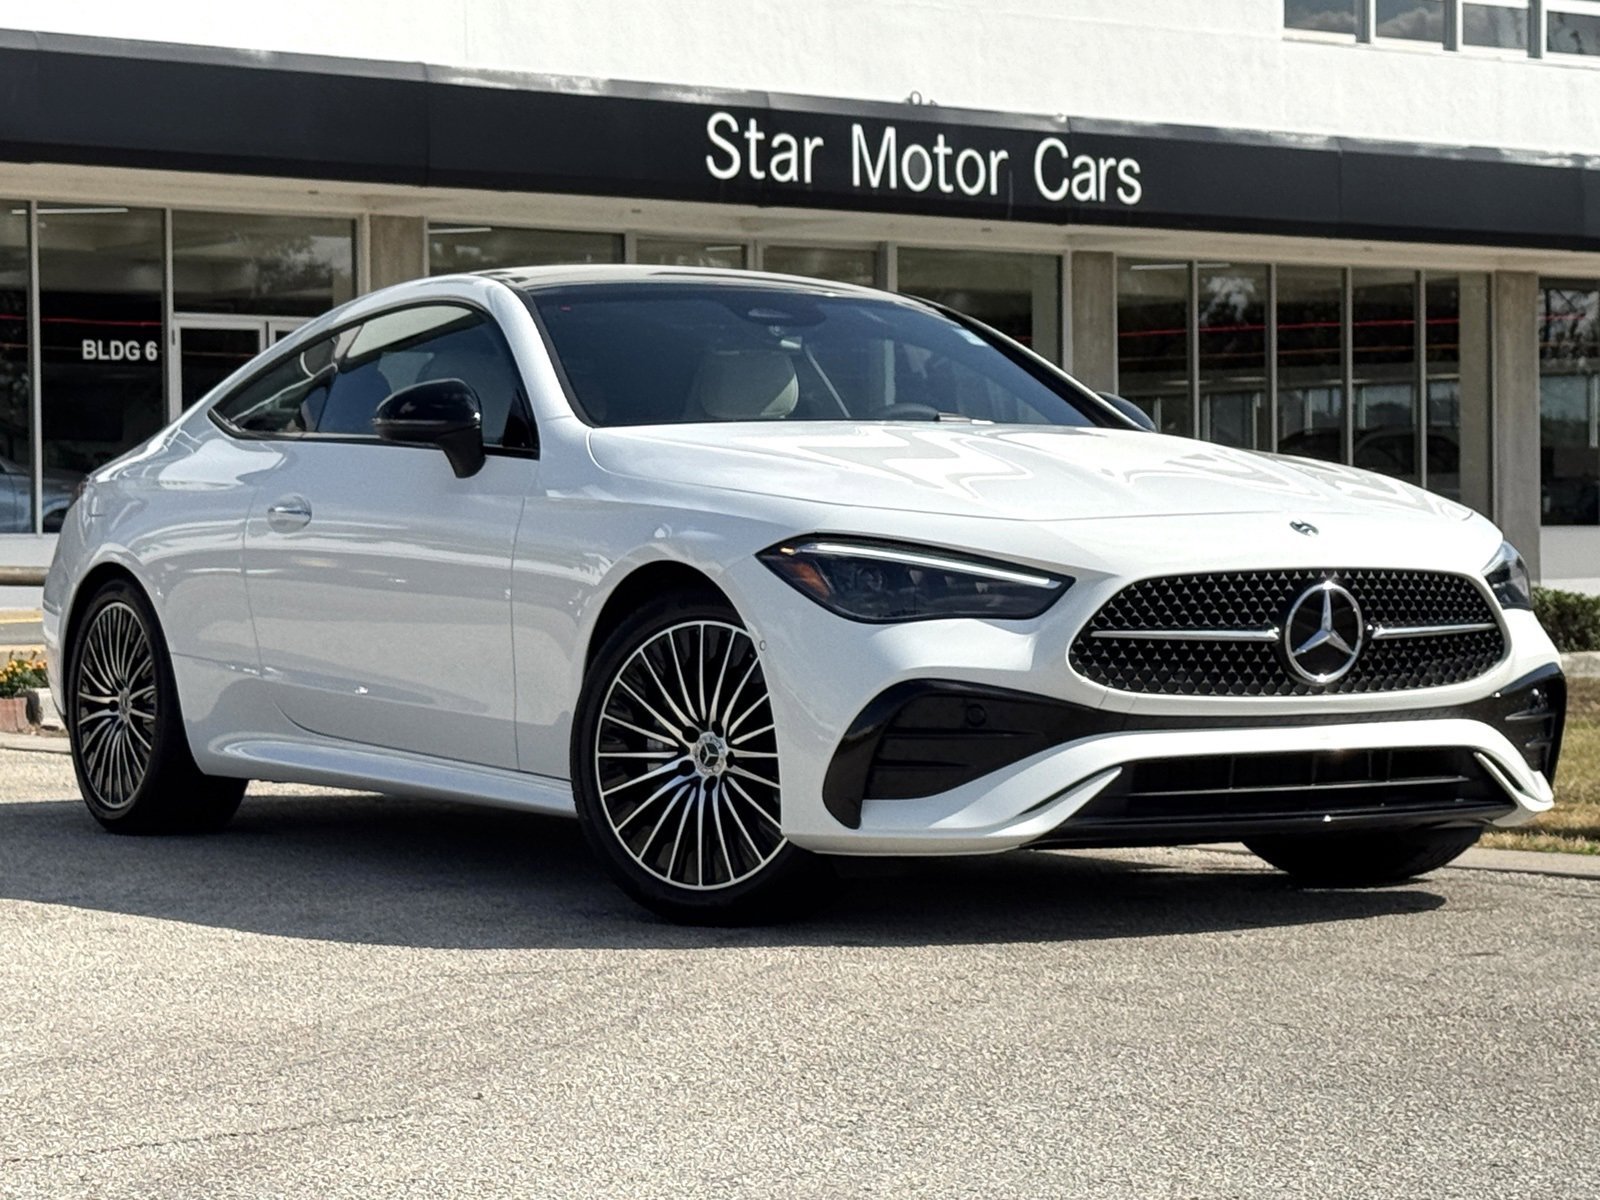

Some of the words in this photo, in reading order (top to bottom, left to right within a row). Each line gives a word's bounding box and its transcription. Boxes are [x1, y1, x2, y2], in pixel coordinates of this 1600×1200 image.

[705, 111, 824, 184] Star
[851, 123, 1009, 196] Motor
[1034, 137, 1142, 205] Cars
[82, 339, 141, 361] BLDG
[145, 340, 158, 361] 6
